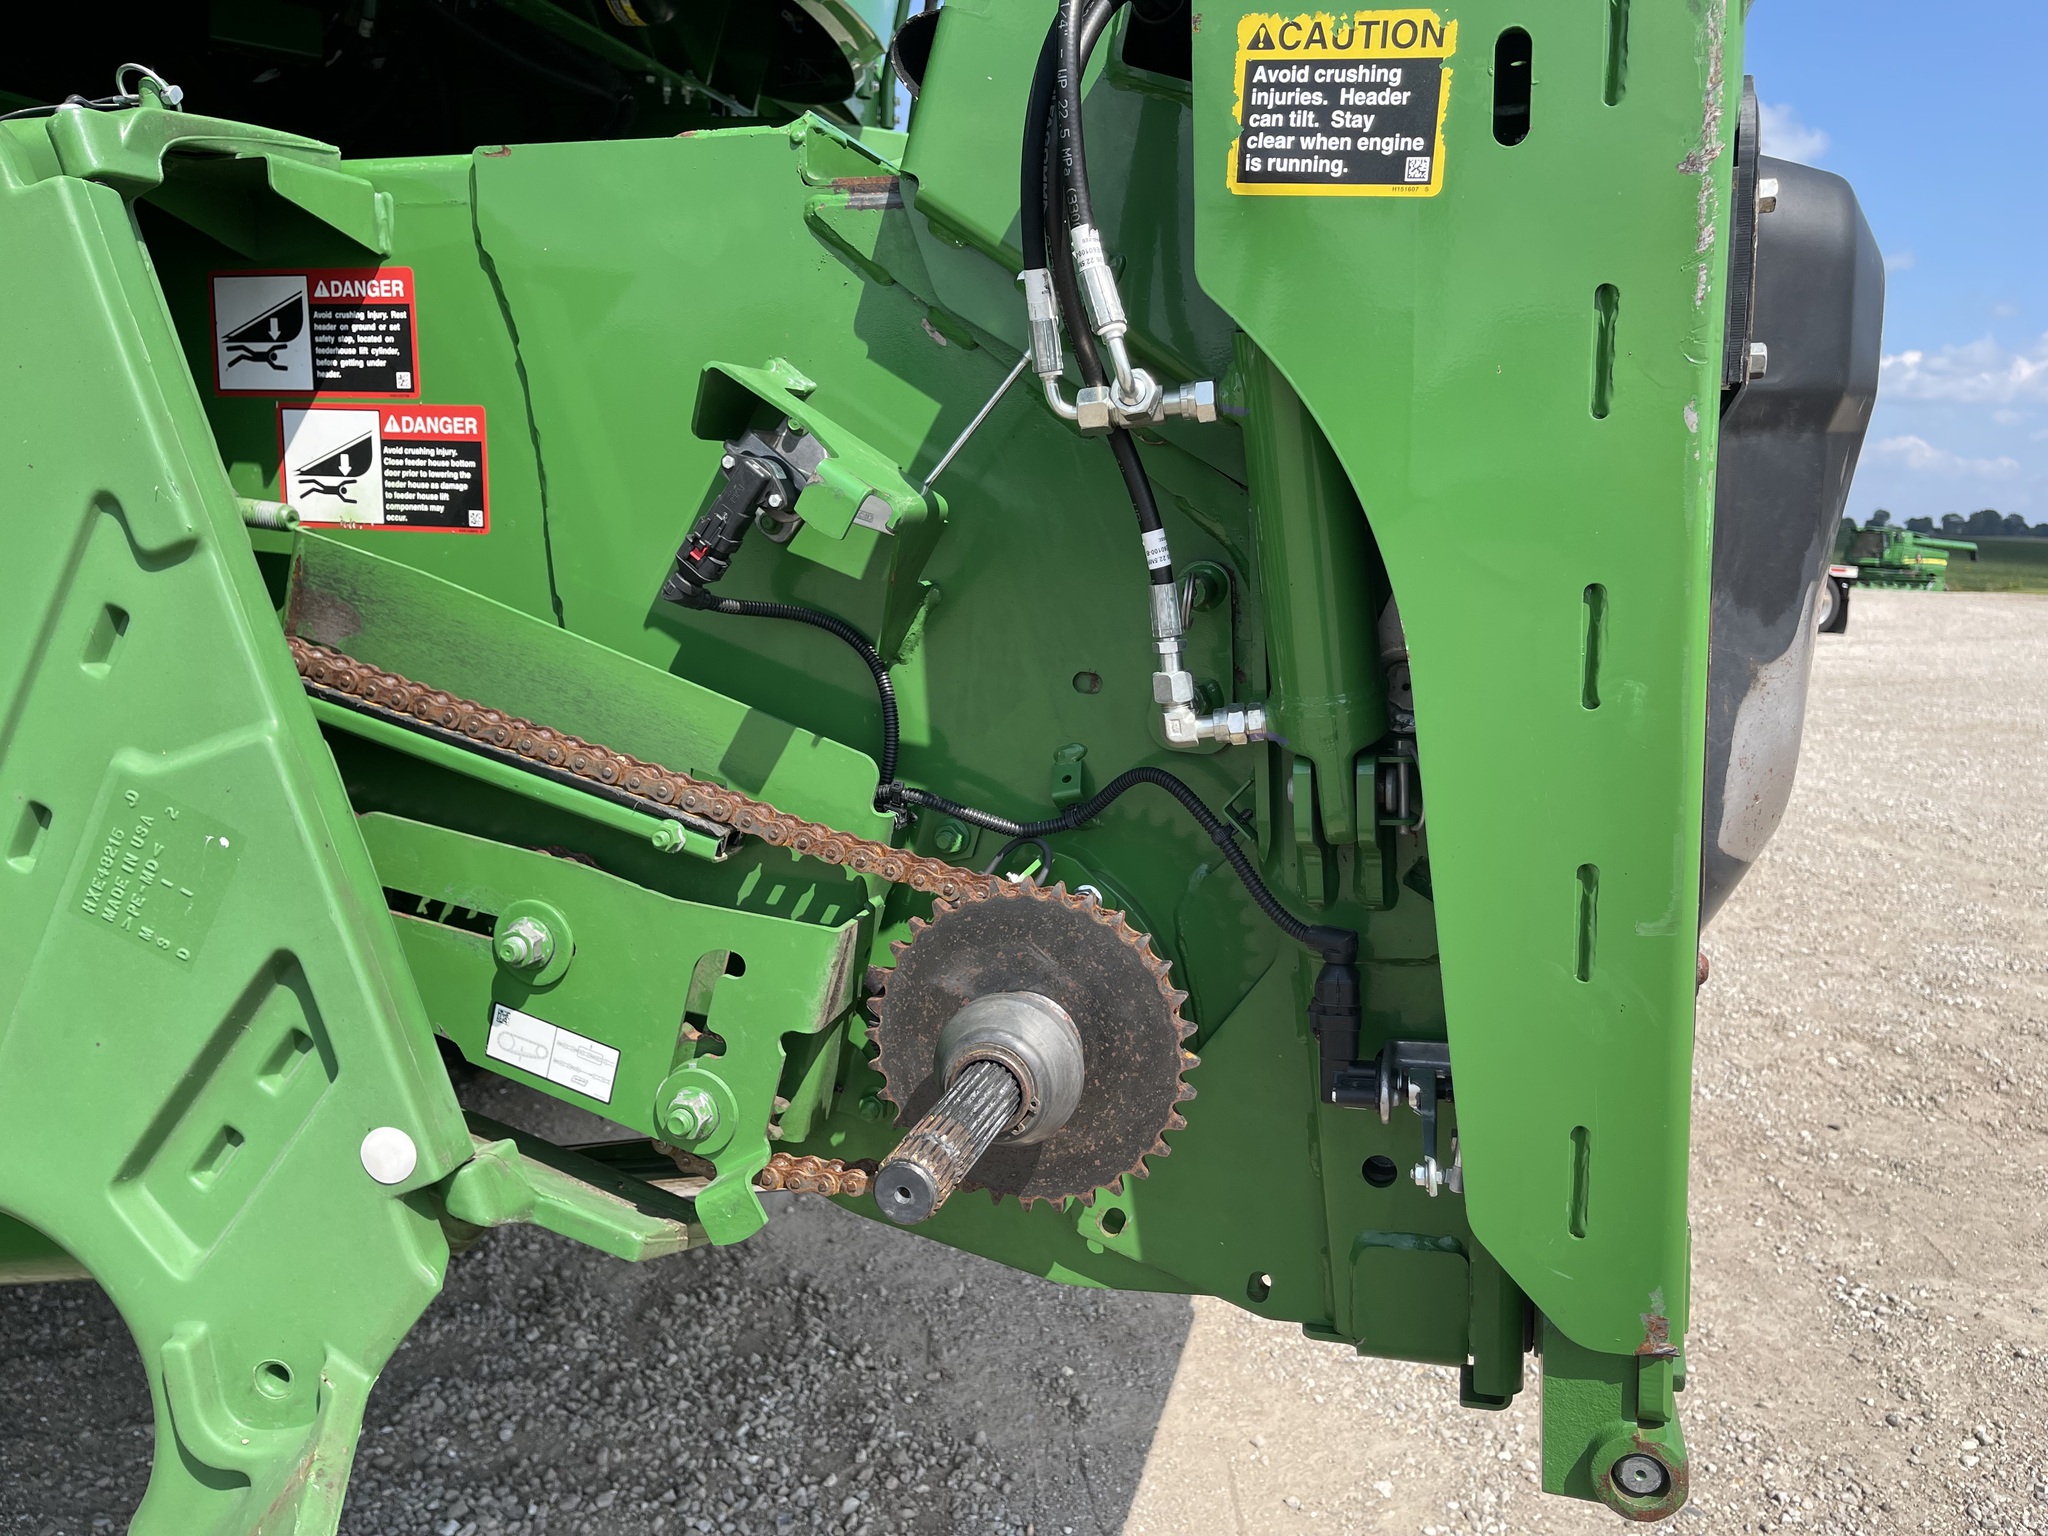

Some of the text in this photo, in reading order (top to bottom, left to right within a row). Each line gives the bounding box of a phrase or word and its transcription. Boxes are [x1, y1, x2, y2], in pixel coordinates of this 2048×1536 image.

[1278, 19, 1445, 51] CAUTION
[1252, 65, 1402, 87] Avoid crushing
[1251, 88, 1411, 110] injuries. Header
[1249, 109, 1375, 133] can tilt. Stay
[1246, 133, 1425, 155] clear when engine
[1061, 147, 1073, 177] MPa
[1244, 154, 1349, 177] is running.
[330, 280, 405, 298] DANGER
[313, 310, 333, 319] Avoid
[334, 311, 365, 321] crushing
[390, 310, 407, 319] Rest
[313, 323, 337, 331] header
[339, 323, 349, 331] on
[351, 323, 376, 333] ground
[389, 323, 401, 331] set
[314, 334, 395, 345] safety stop, located on
[315, 346, 400, 357] feederhouse lift cylinder,
[315, 358, 387, 369] before getting under
[316, 369, 342, 379] header.
[401, 416, 478, 435] DANGER
[382, 446, 403, 455] Avoid
[404, 446, 436, 457] crushing
[383, 457, 477, 468] Close feeder house bottom
[383, 469, 472, 481] door prior to lowering the
[384, 480, 407, 488] feeder
[407, 480, 430, 489] house
[440, 481, 469, 492] damage
[384, 491, 450, 501] to feeder house lift
[385, 503, 445, 514] components may
[385, 514, 409, 522] occur.
[101, 814, 156, 923] MADE IN USA
[138, 925, 155, 942] M
[156, 936, 171, 951] S
[176, 946, 192, 962] D
